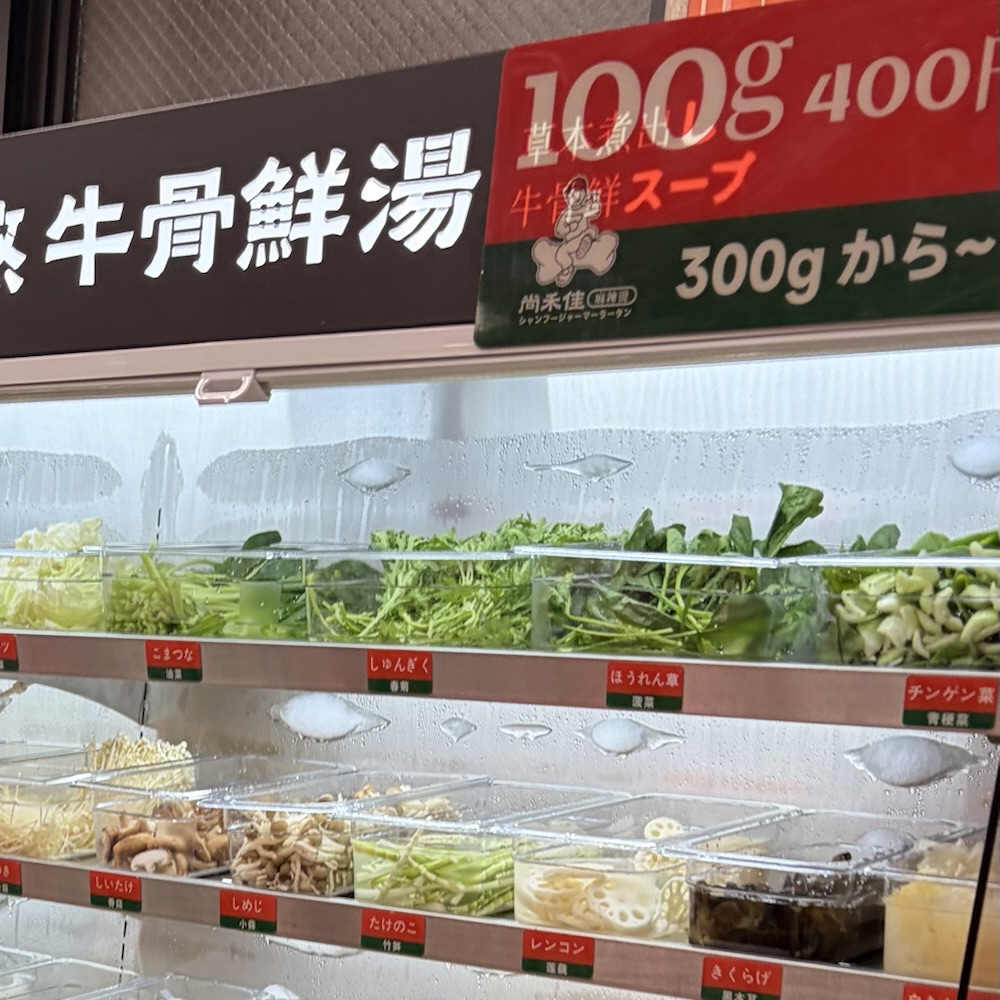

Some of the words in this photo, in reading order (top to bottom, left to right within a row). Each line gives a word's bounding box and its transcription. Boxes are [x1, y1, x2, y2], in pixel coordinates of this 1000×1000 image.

[516, 35, 794, 170] 100g
[45, 128, 482, 287] 牛骨鮮湯
[675, 238, 826, 305] 300g
[518, 290, 586, 314] 尚禾佳
[152, 647, 193, 663] こまつな
[370, 656, 429, 673] しゅんぎく
[610, 669, 680, 687] ほうれん草
[908, 684, 996, 705] チンゲン菜
[95, 876, 134, 895] しいたけ
[231, 897, 263, 914] しめじ
[369, 916, 417, 935] たけのこ
[531, 938, 585, 956] レンコン
[711, 964, 772, 986] きくらげ
